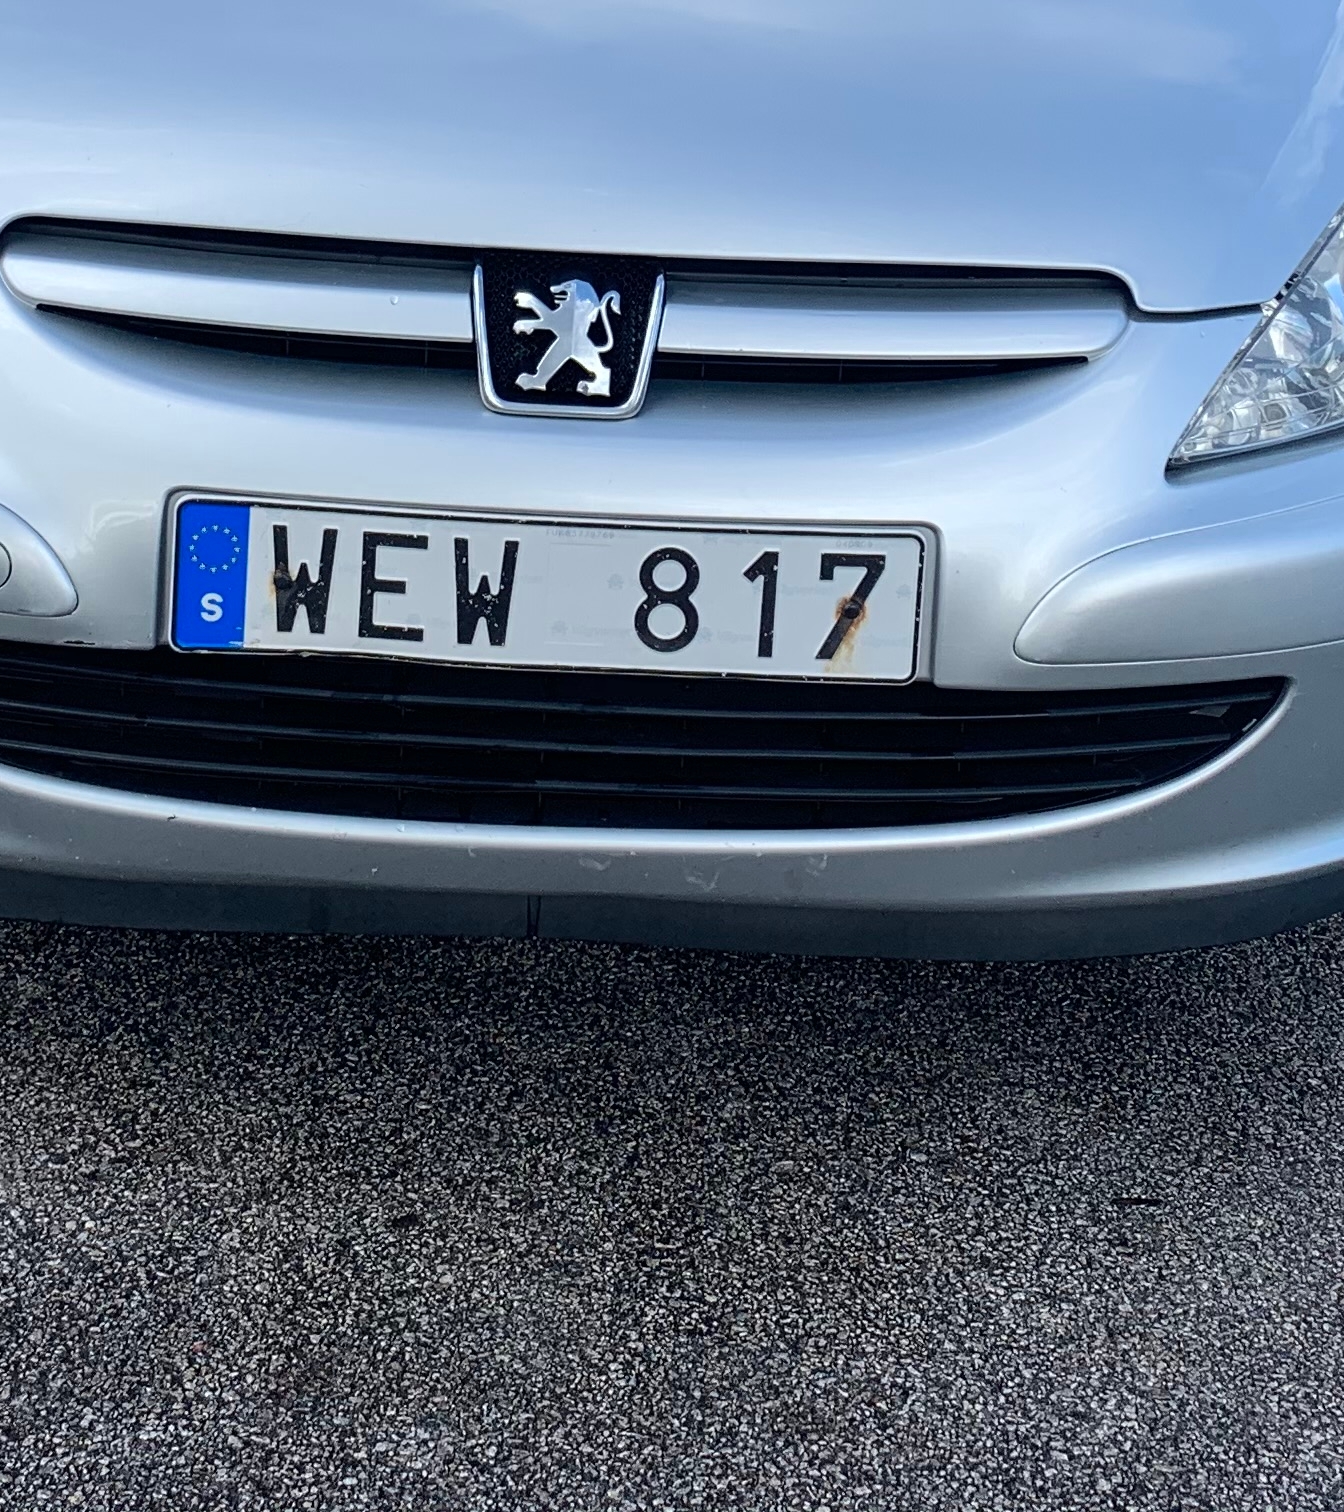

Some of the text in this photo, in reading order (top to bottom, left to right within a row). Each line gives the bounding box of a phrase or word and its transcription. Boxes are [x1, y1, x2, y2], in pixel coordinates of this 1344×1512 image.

[201, 524, 886, 660] S WEW 817
